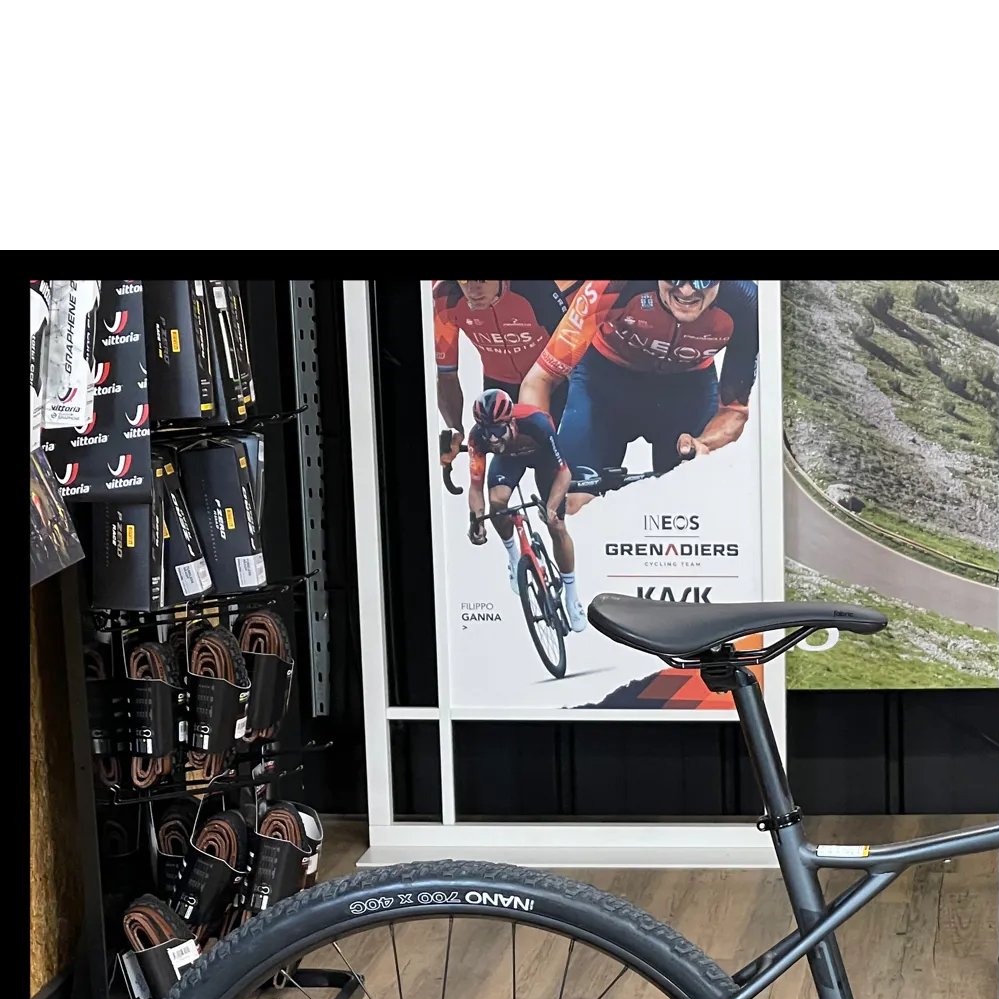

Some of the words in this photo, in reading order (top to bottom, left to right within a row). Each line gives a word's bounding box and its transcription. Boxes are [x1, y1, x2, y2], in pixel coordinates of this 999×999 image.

[116, 284, 142, 296] vitto
[557, 283, 598, 350] INEOS
[65, 292, 77, 375] GRAPHENE
[102, 332, 140, 347] vittoria
[473, 331, 532, 343] INEOS
[94, 383, 122, 396] ttoria
[123, 428, 150, 439] vitto
[70, 434, 109, 448] vittoria
[105, 476, 143, 490] vittoria
[59, 484, 91, 497] ittoria
[644, 514, 700, 530] INEOS
[605, 543, 739, 556] GRENADIERS
[461, 602, 494, 610] FILIPPO
[461, 613, 502, 621] GANNA
[834, 610, 854, 618] fabric
[417, 891, 461, 904] 700
[350, 897, 394, 915] 40C
